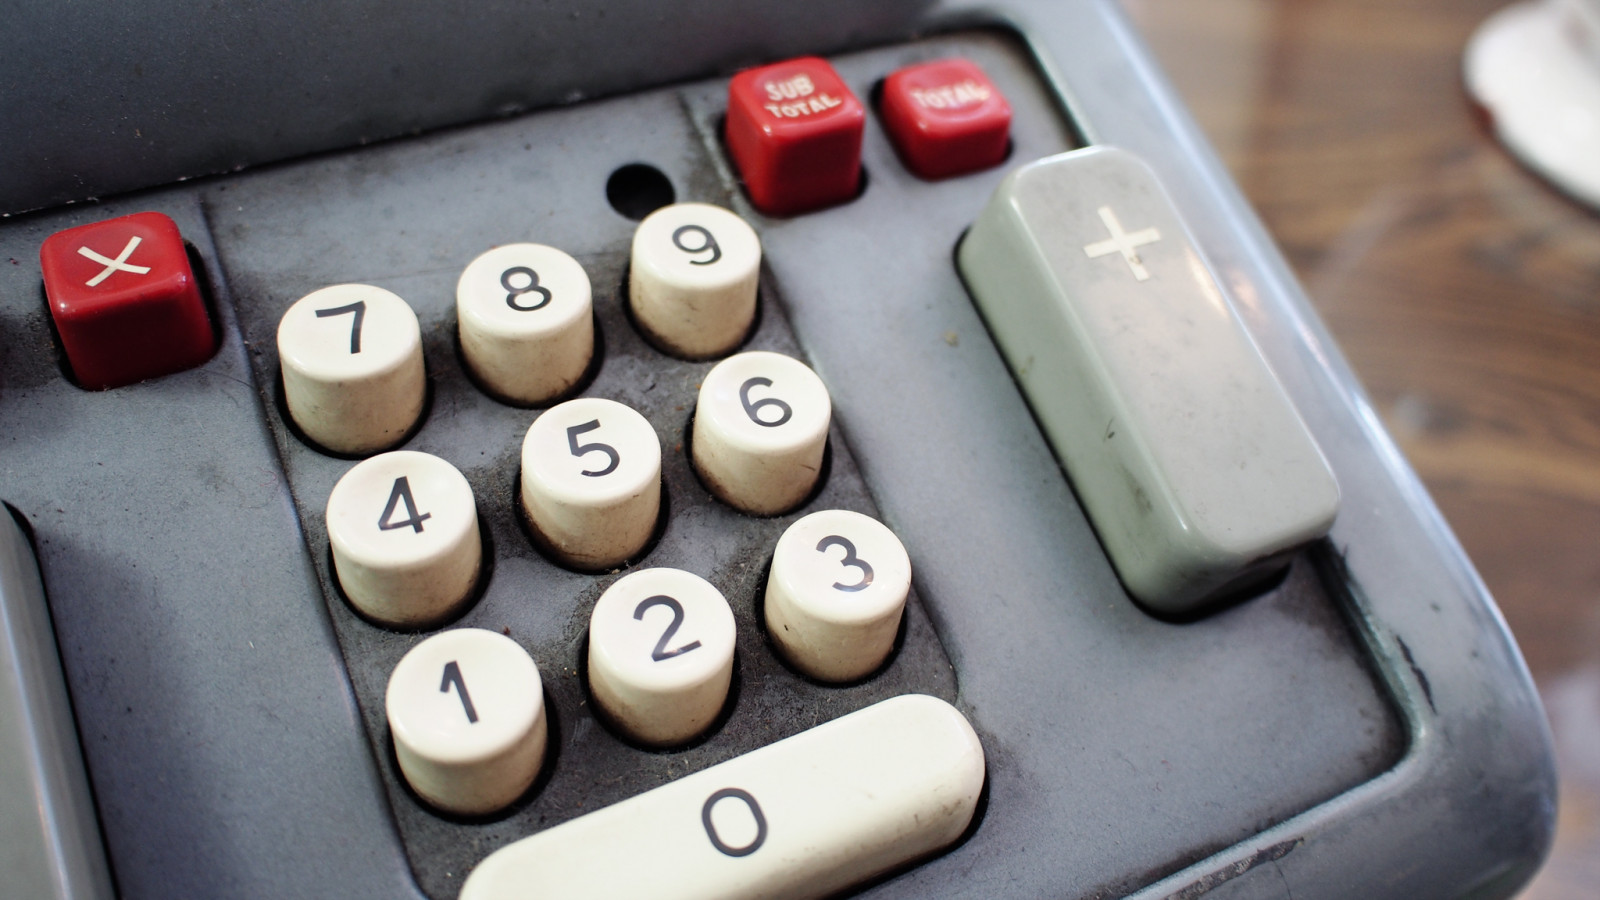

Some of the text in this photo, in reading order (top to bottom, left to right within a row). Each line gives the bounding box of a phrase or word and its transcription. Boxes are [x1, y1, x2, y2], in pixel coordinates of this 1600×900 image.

[764, 73, 815, 101] SUB
[764, 93, 842, 118] TOTAL
[909, 80, 991, 109] TOTAL
[671, 223, 722, 267] 9
[499, 266, 553, 312] 8
[315, 300, 366, 355] 7
[738, 376, 793, 429] 6
[566, 418, 620, 478] 5
[377, 475, 432, 535] 4
[815, 534, 875, 594] 3
[633, 594, 702, 662] 2
[439, 660, 479, 724] 1
[701, 787, 768, 858] 0
